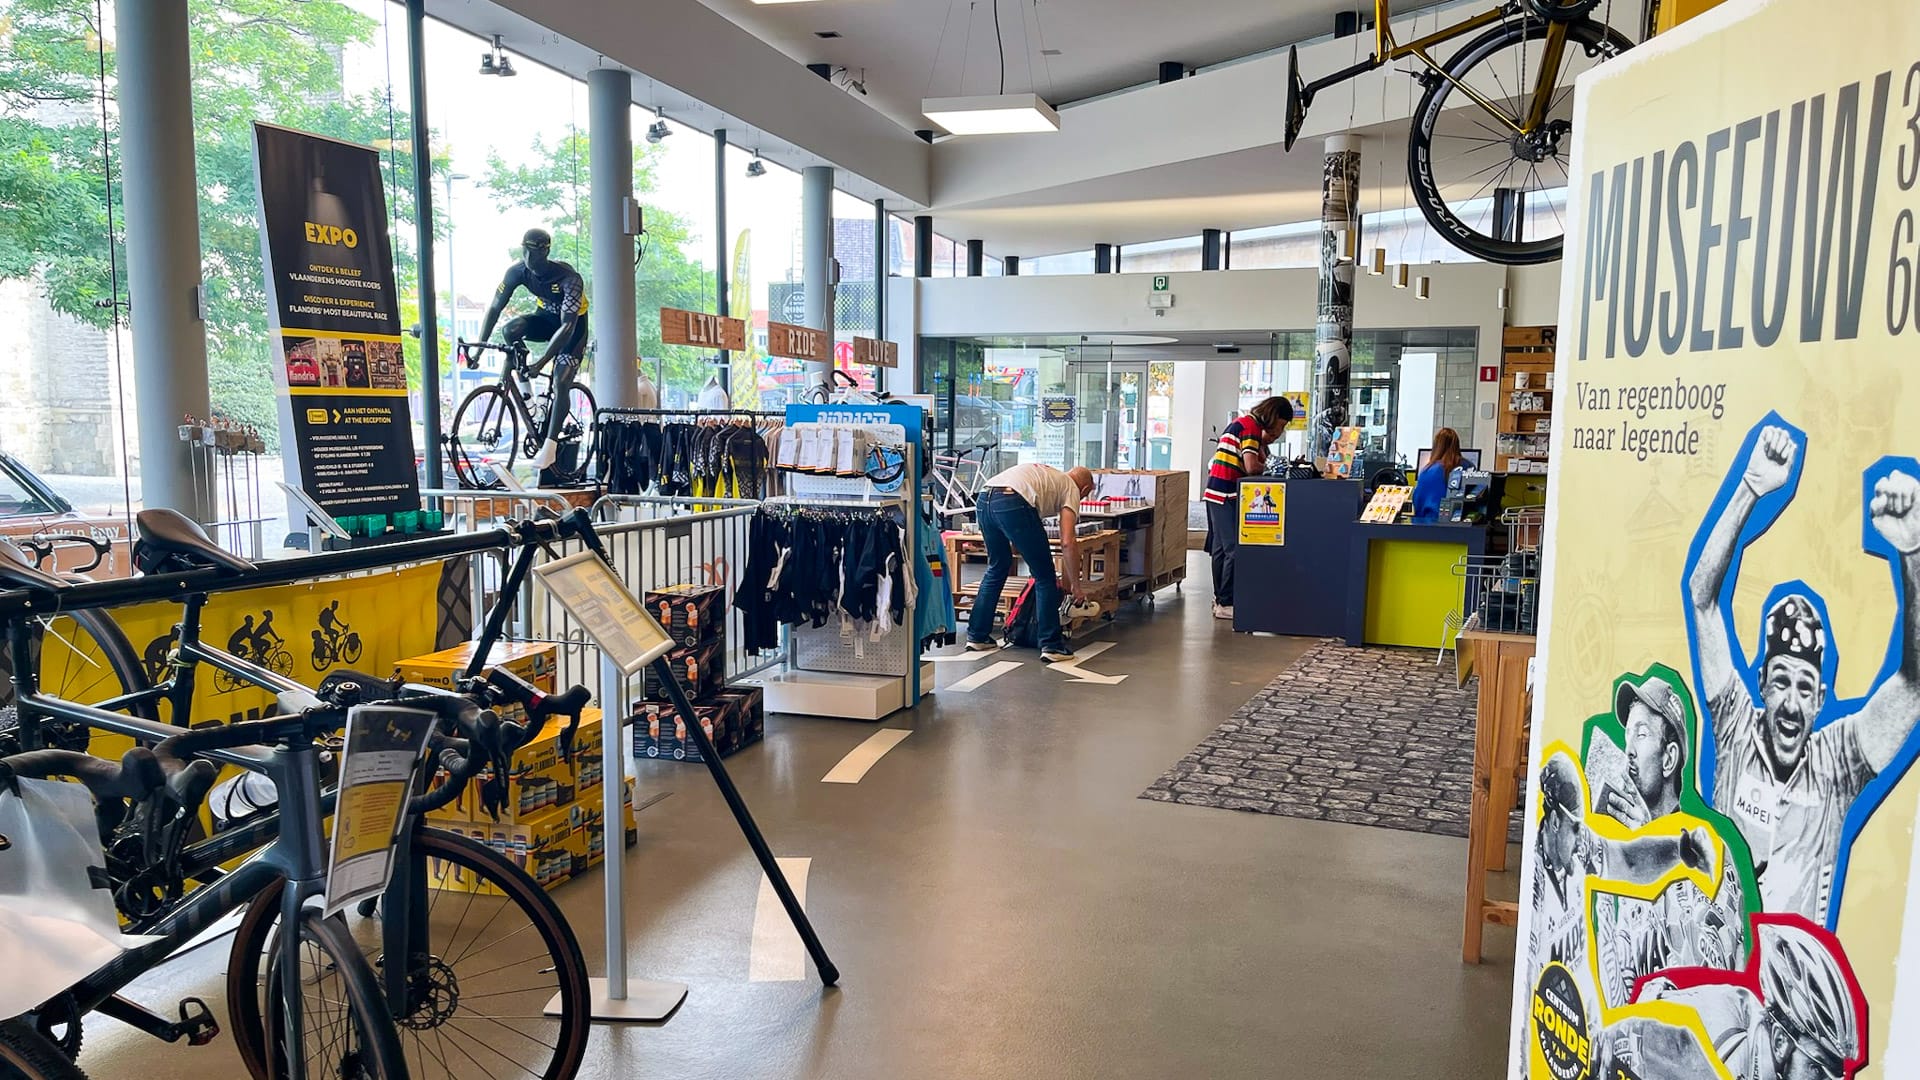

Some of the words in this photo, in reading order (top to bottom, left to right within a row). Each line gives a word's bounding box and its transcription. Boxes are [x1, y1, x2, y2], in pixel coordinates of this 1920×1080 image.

[1578, 70, 1892, 361] MUSEEUW
[304, 221, 358, 248] EXPO
[289, 272, 335, 285] VLAANDERENS
[335, 278, 362, 288] MOOISTE
[362, 280, 382, 290] KOERS
[309, 263, 334, 274] ONTDEK
[340, 266, 362, 277] BELEEF
[303, 295, 334, 305] DISCOVER
[339, 298, 375, 309] EXPERIENCE
[323, 307, 341, 316] MOST
[342, 308, 374, 319] BEAUTIFUL
[687, 313, 725, 344] LIVE
[788, 328, 816, 356] RIDE
[868, 340, 890, 363] LOVE
[1576, 382, 1611, 410] Van
[1617, 376, 1727, 420] regenboog
[1572, 426, 1616, 450] naar
[1621, 421, 1699, 462] legende
[1736, 796, 1771, 825] MAPEI
[1545, 987, 1579, 1027] CENTRUM
[1534, 994, 1589, 1066] RONDE
[1540, 1030, 1579, 1079] VLAANDEREN
[1552, 1041, 1566, 1061] VAN
